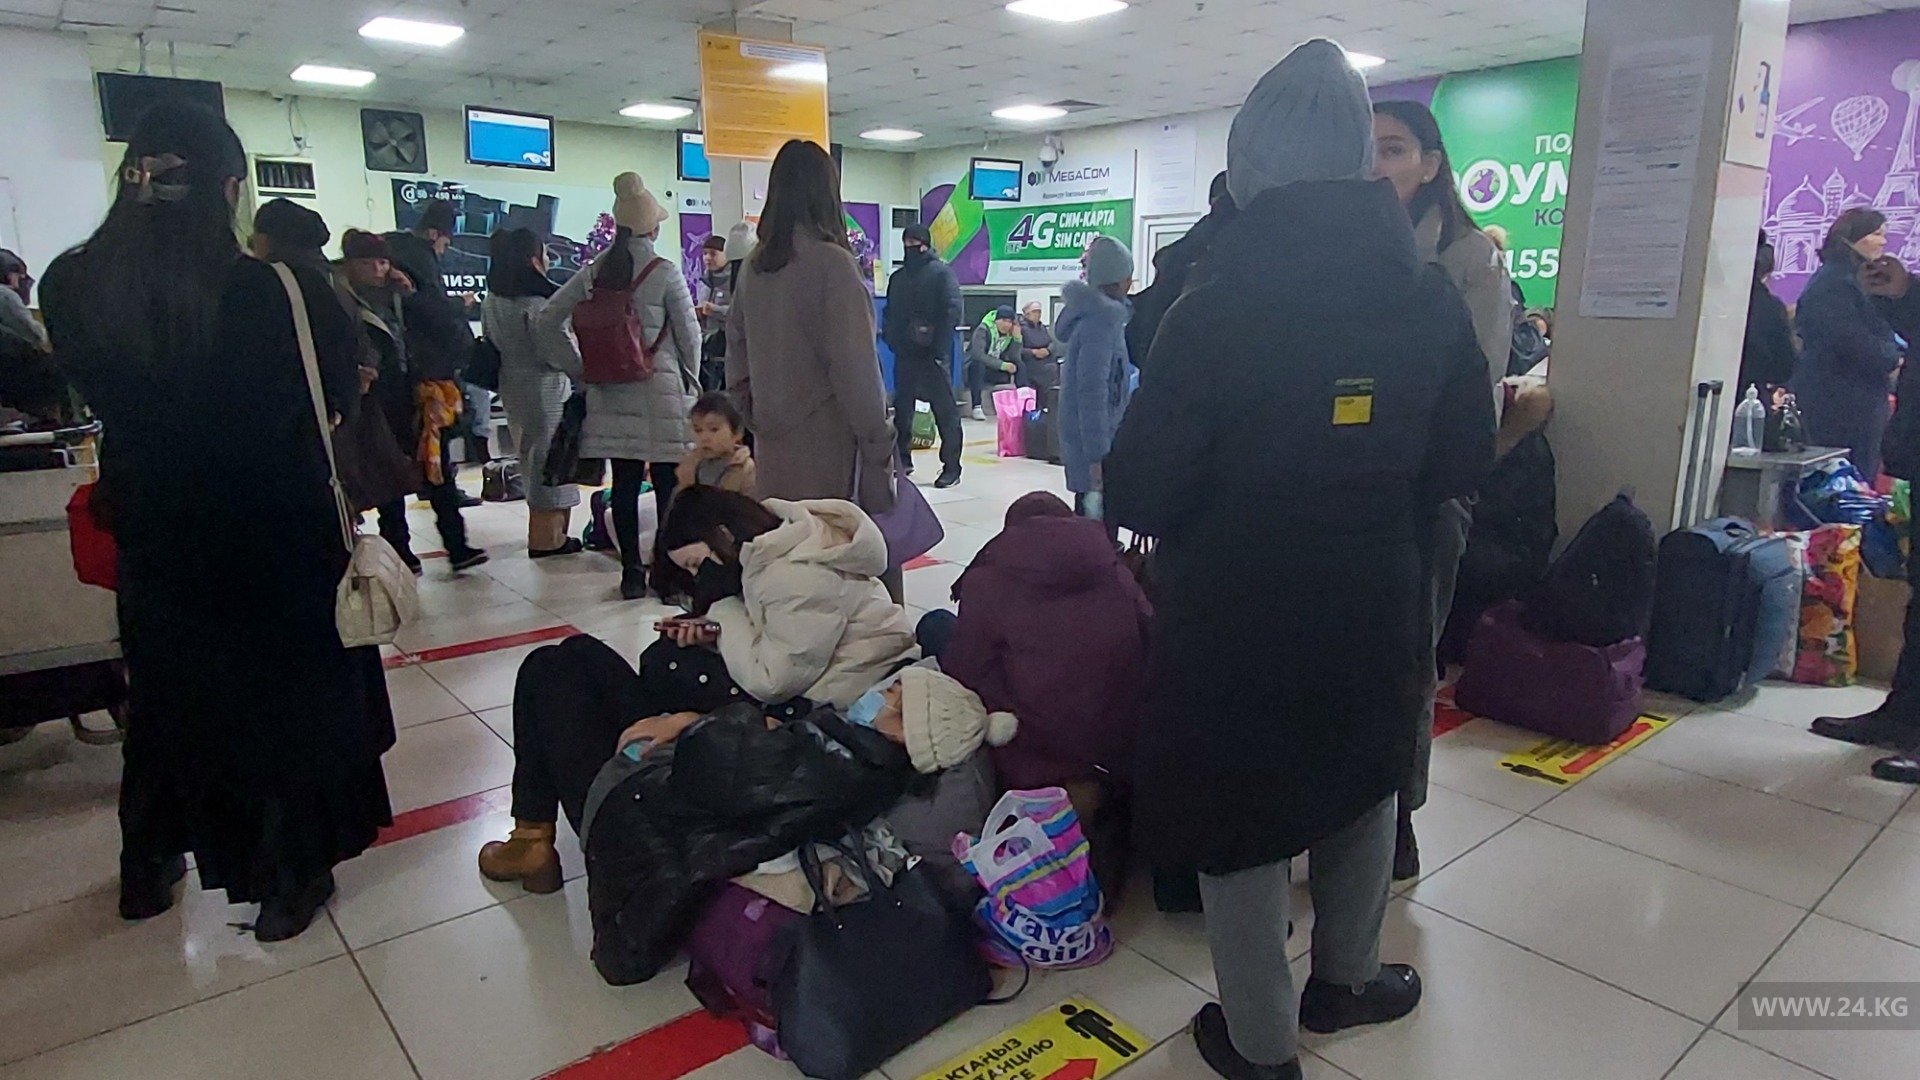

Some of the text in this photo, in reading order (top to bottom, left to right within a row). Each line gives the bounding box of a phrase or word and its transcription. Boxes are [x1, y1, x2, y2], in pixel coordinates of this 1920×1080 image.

[1535, 133, 1572, 155] ПО
[1059, 209, 1115, 228] СИМ-КАРТА
[1007, 211, 1058, 249] 4G
[1054, 231, 1073, 249] SIM
